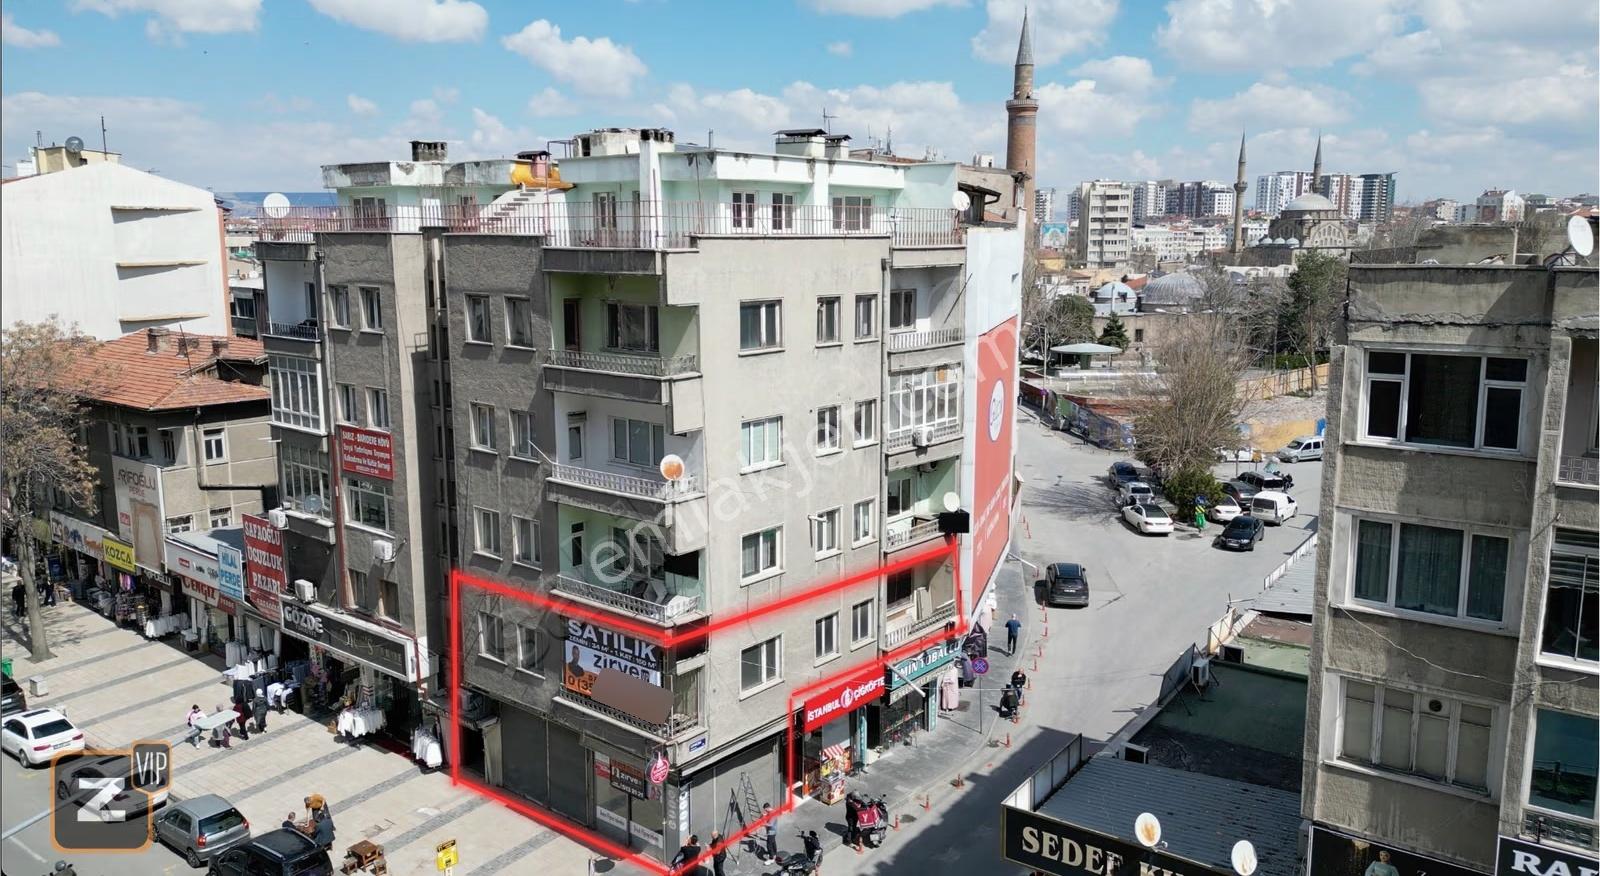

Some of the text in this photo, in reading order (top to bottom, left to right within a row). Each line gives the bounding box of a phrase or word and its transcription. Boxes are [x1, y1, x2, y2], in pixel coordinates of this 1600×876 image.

[105, 544, 132, 565] KOZCA
[252, 571, 281, 596] PAZARI
[284, 605, 324, 633] GÖZDE
[568, 619, 657, 662] SATILIK
[593, 653, 640, 679] zirve
[807, 702, 841, 723] İSTANBUL
[1022, 826, 1123, 876] SEDEF
